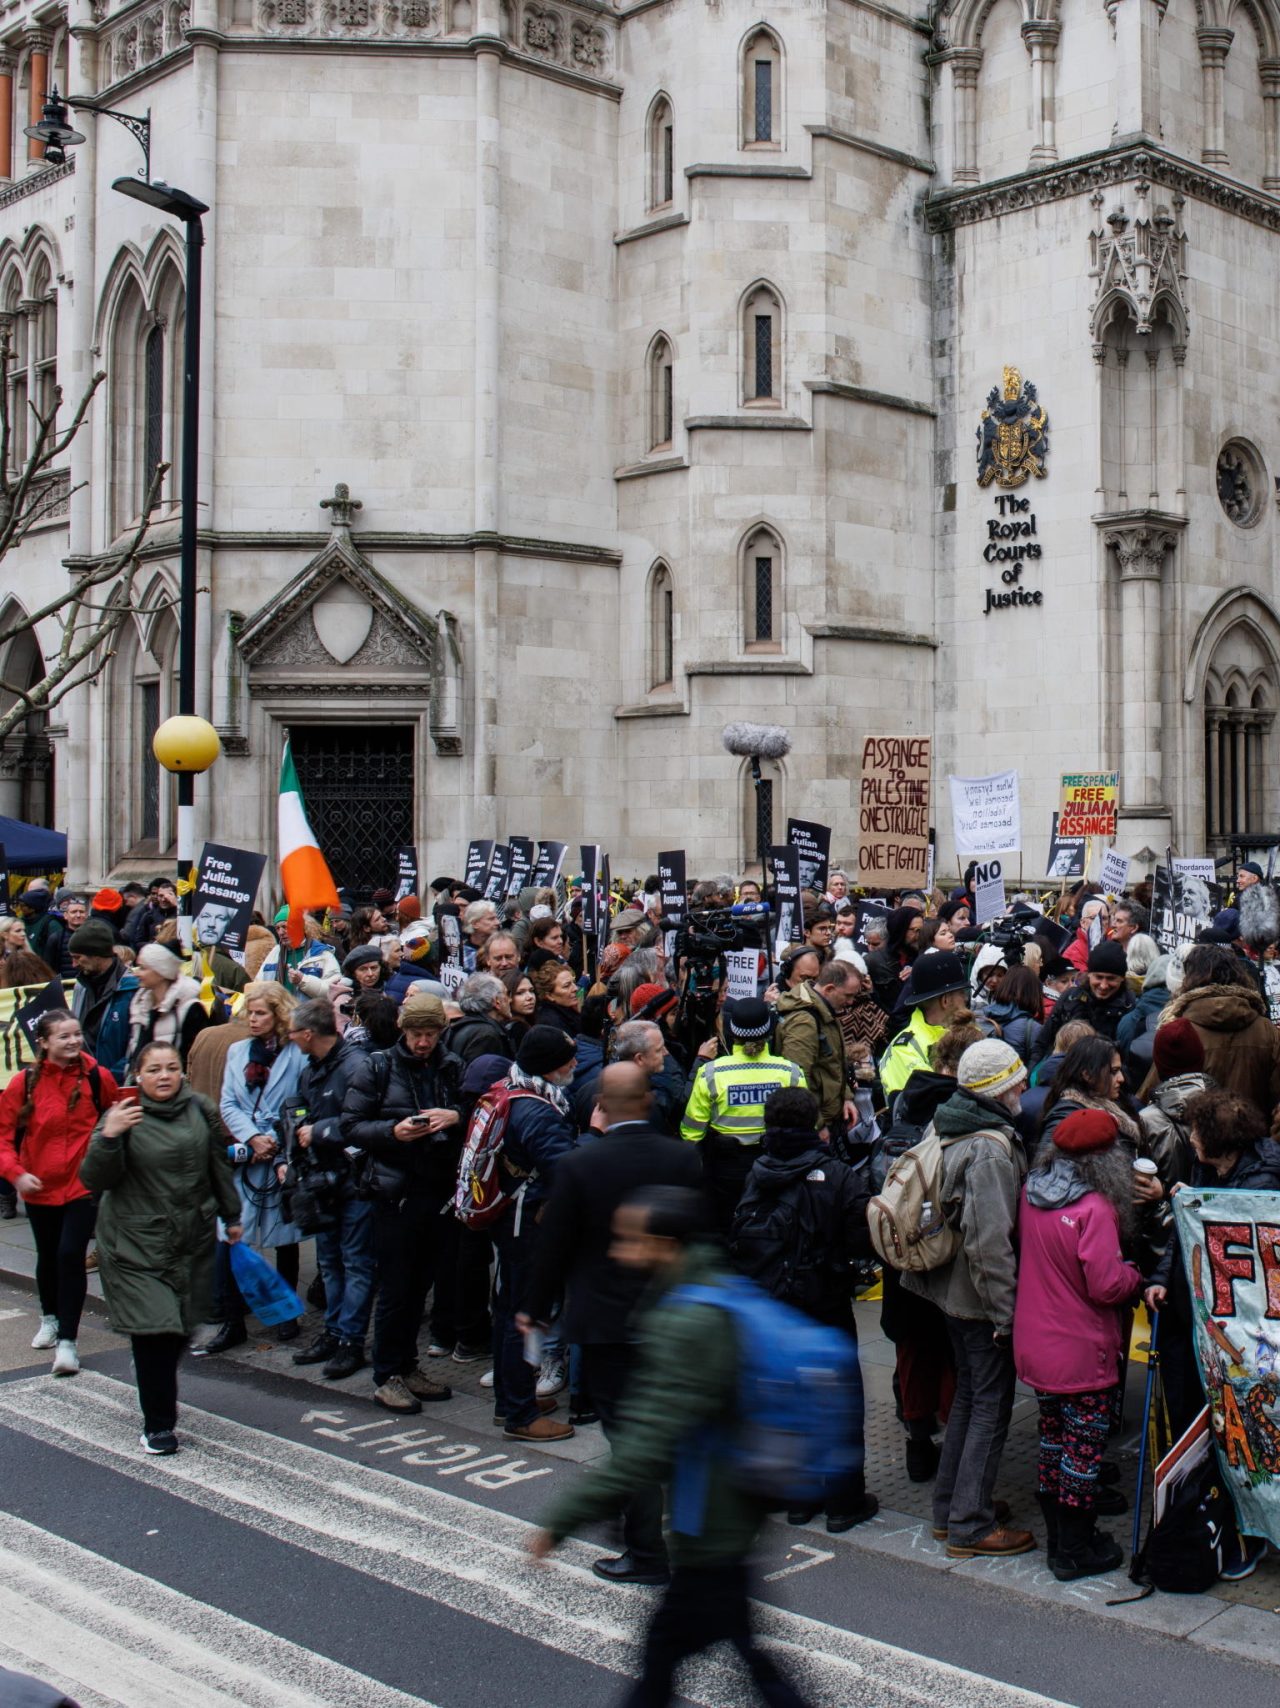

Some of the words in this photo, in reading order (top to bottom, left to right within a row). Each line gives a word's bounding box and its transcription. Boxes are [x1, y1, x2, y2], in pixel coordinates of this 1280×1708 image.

[994, 494, 1030, 516] The
[987, 514, 1036, 541] Royal
[983, 542, 1042, 562] Courts
[1001, 562, 1023, 584] of
[983, 586, 1042, 615] Justice
[862, 738, 929, 769] ASSANGE
[889, 768, 905, 781] TO
[861, 778, 928, 806] PALESTINE
[1074, 788, 1105, 801] FREE
[1064, 800, 1115, 817] JULIAN
[1060, 809, 1118, 836] ASSANGE!
[791, 827, 811, 838] Free
[791, 837, 818, 849] Julian
[1054, 836, 1085, 846] Assange
[797, 846, 826, 861] ssange
[859, 844, 885, 871] ONE
[887, 845, 927, 873] FIGHT!
[1106, 853, 1128, 870] FREE
[205, 856, 232, 871] Free
[660, 866, 672, 877] Free
[774, 858, 785, 869] Free
[1104, 865, 1125, 878] JULIAN
[1175, 863, 1214, 871] Thordarson
[202, 869, 239, 886] Julian
[976, 860, 1001, 885] NO
[199, 882, 250, 903] Assange
[727, 955, 755, 970] FREE
[727, 975, 753, 985] JULIAN
[729, 1083, 781, 1091] METROPOLITAN
[729, 1089, 777, 1104] POLIC
[312, 1418, 554, 1491] RIGHT
